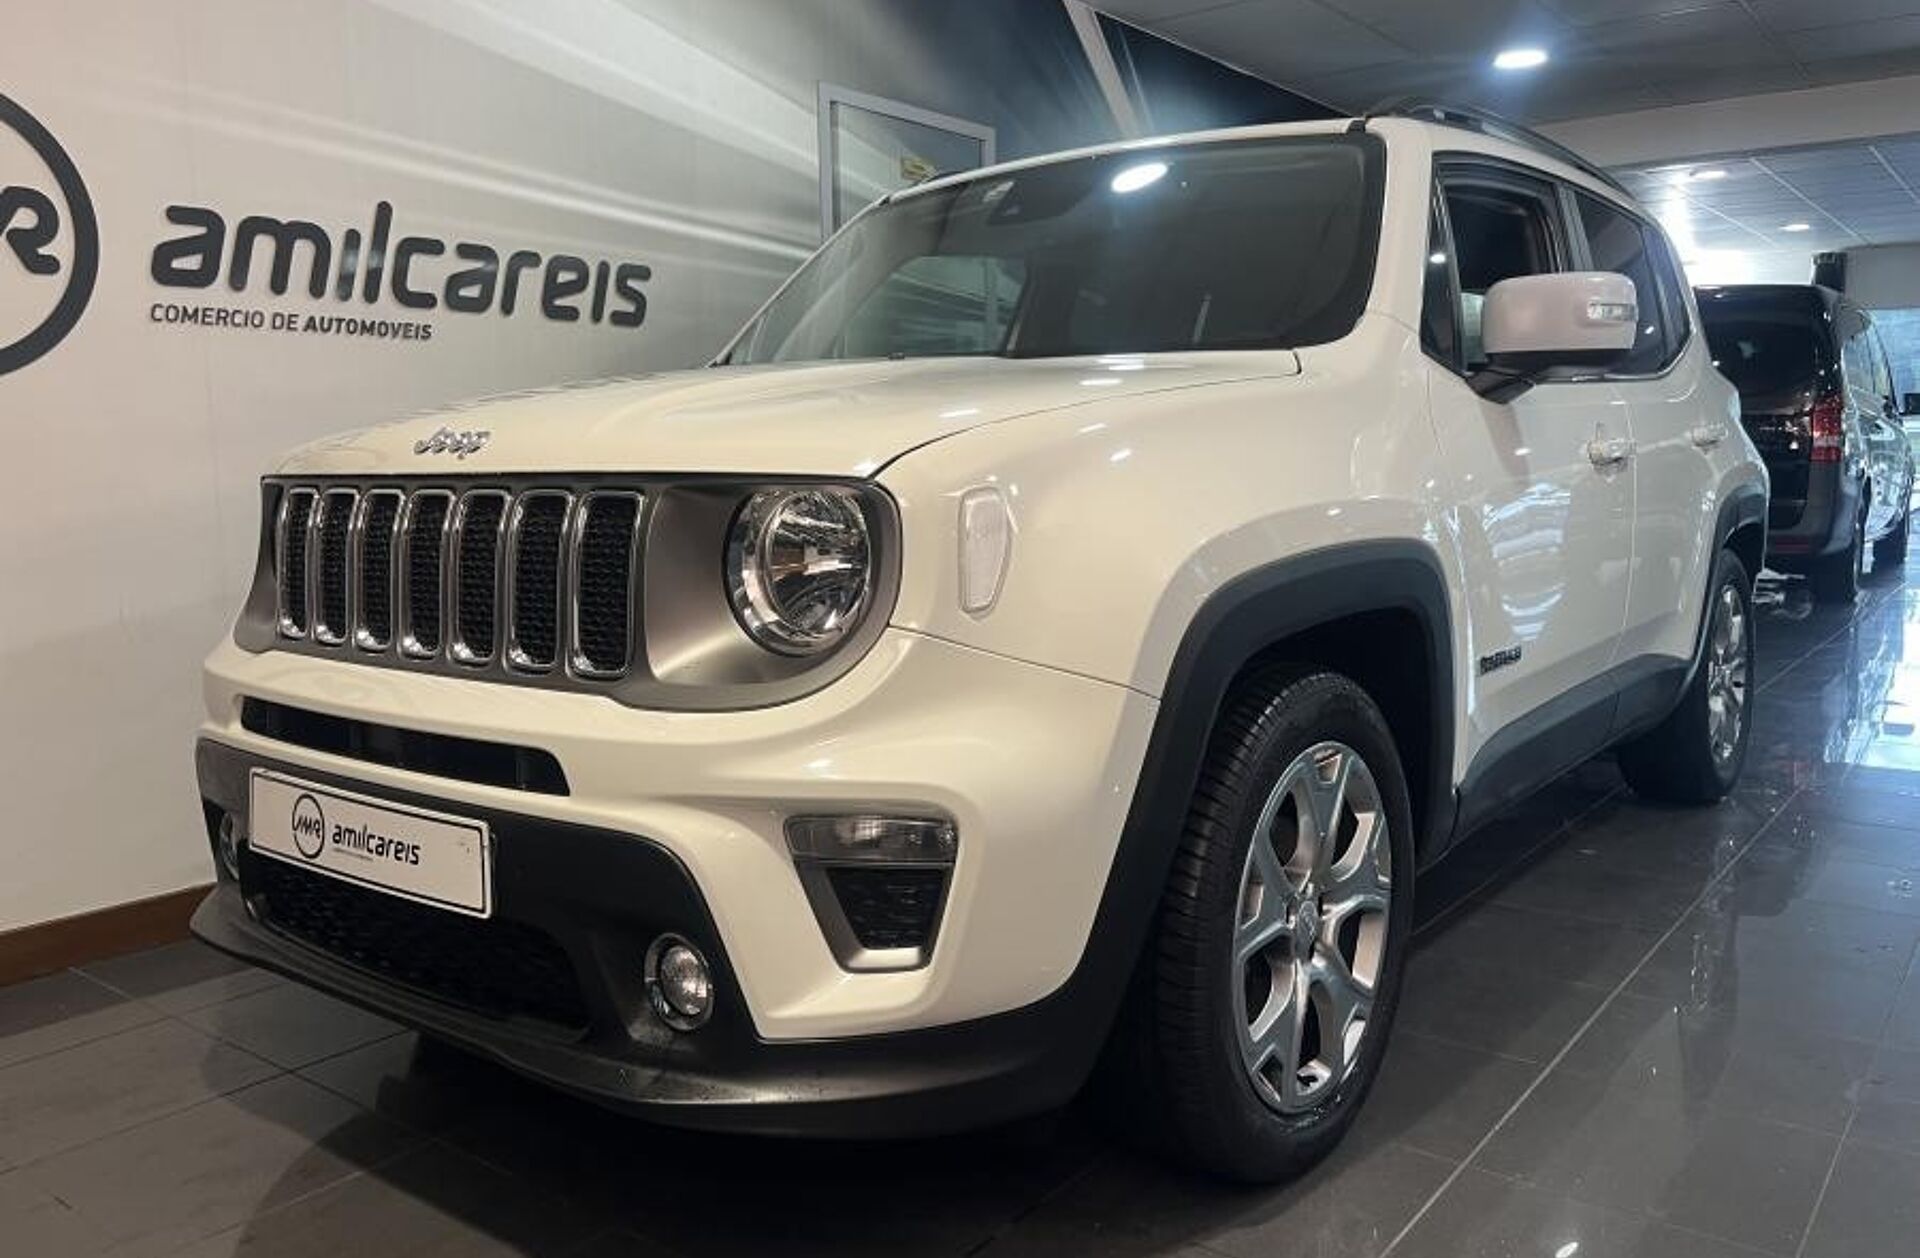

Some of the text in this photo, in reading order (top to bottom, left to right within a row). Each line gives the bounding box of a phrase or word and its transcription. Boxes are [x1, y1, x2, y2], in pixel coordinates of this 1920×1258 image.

[150, 200, 653, 328] amilcareis
[150, 303, 432, 341] COMERCIO DE AUTOMOVEIS
[332, 823, 420, 866] amilcareis
